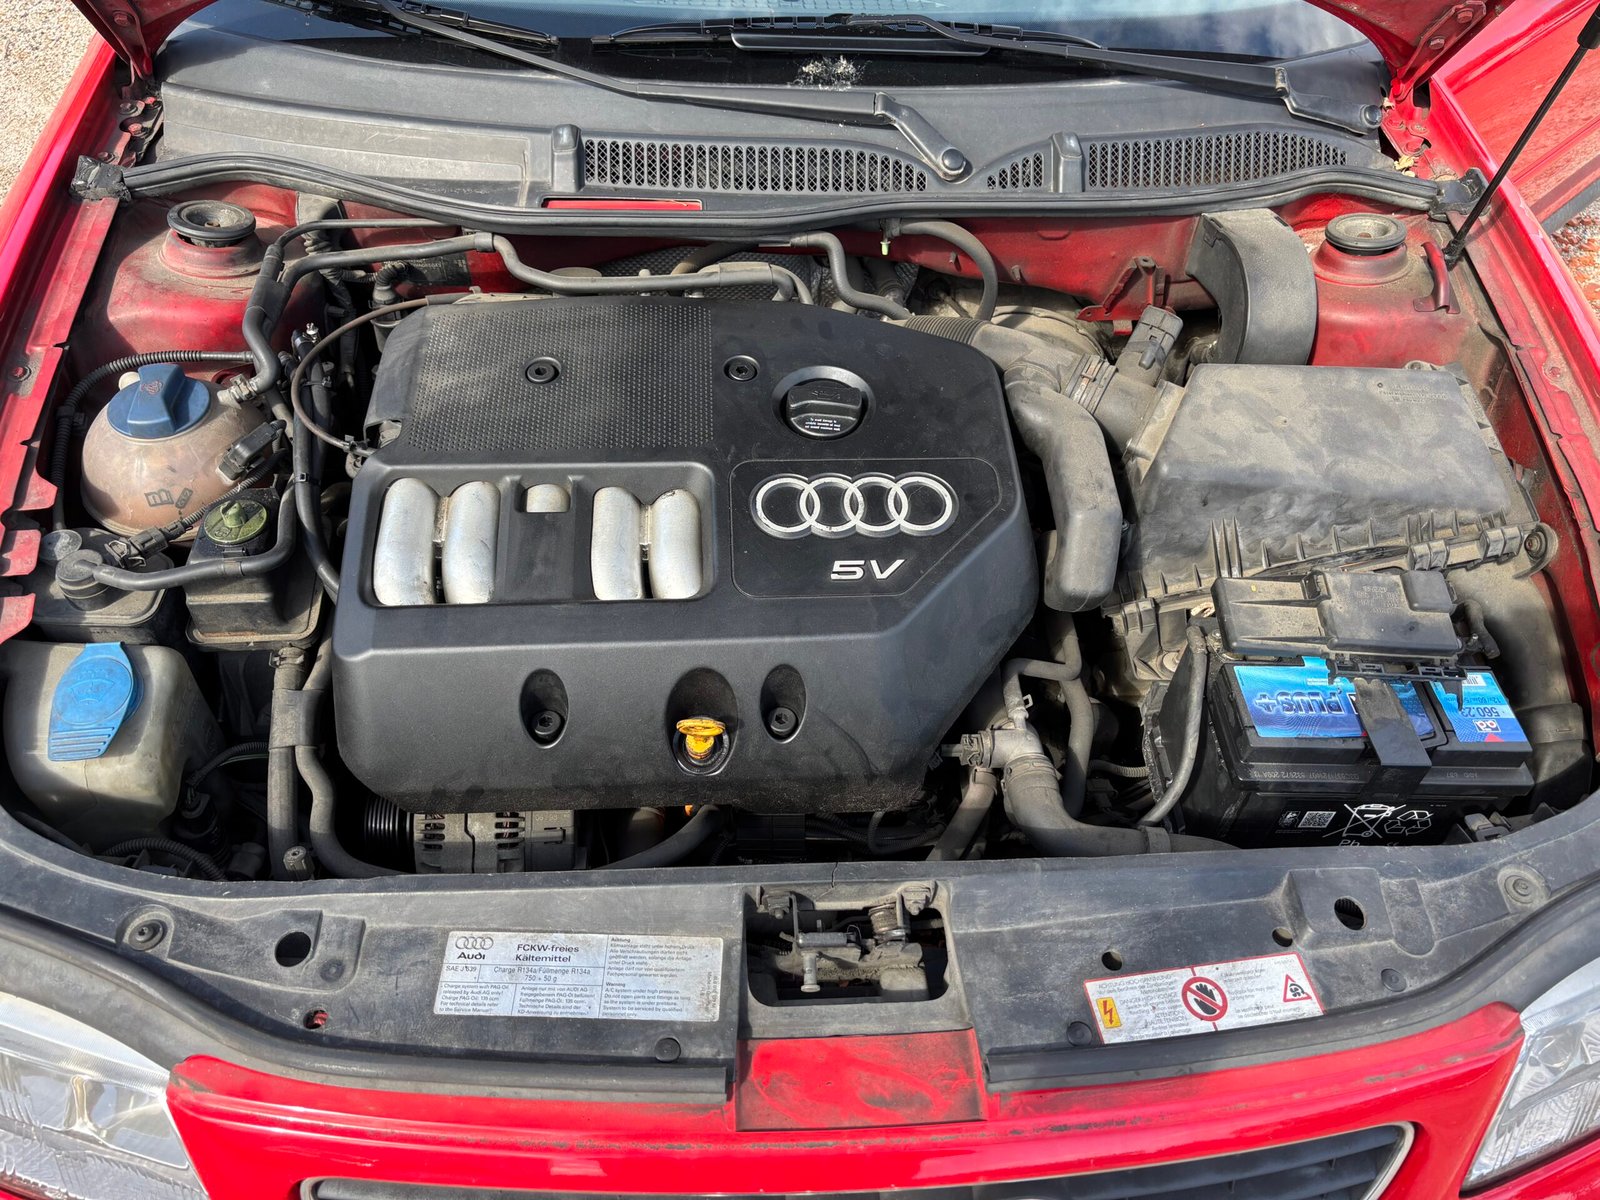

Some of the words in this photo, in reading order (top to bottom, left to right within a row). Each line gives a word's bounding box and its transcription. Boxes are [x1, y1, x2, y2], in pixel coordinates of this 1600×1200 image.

[831, 559, 905, 580] 5V
[1254, 691, 1344, 715] PLUS+
[516, 944, 579, 952] FCKW-freies
[457, 952, 485, 960] Audi
[515, 954, 571, 962] Kältemittel
